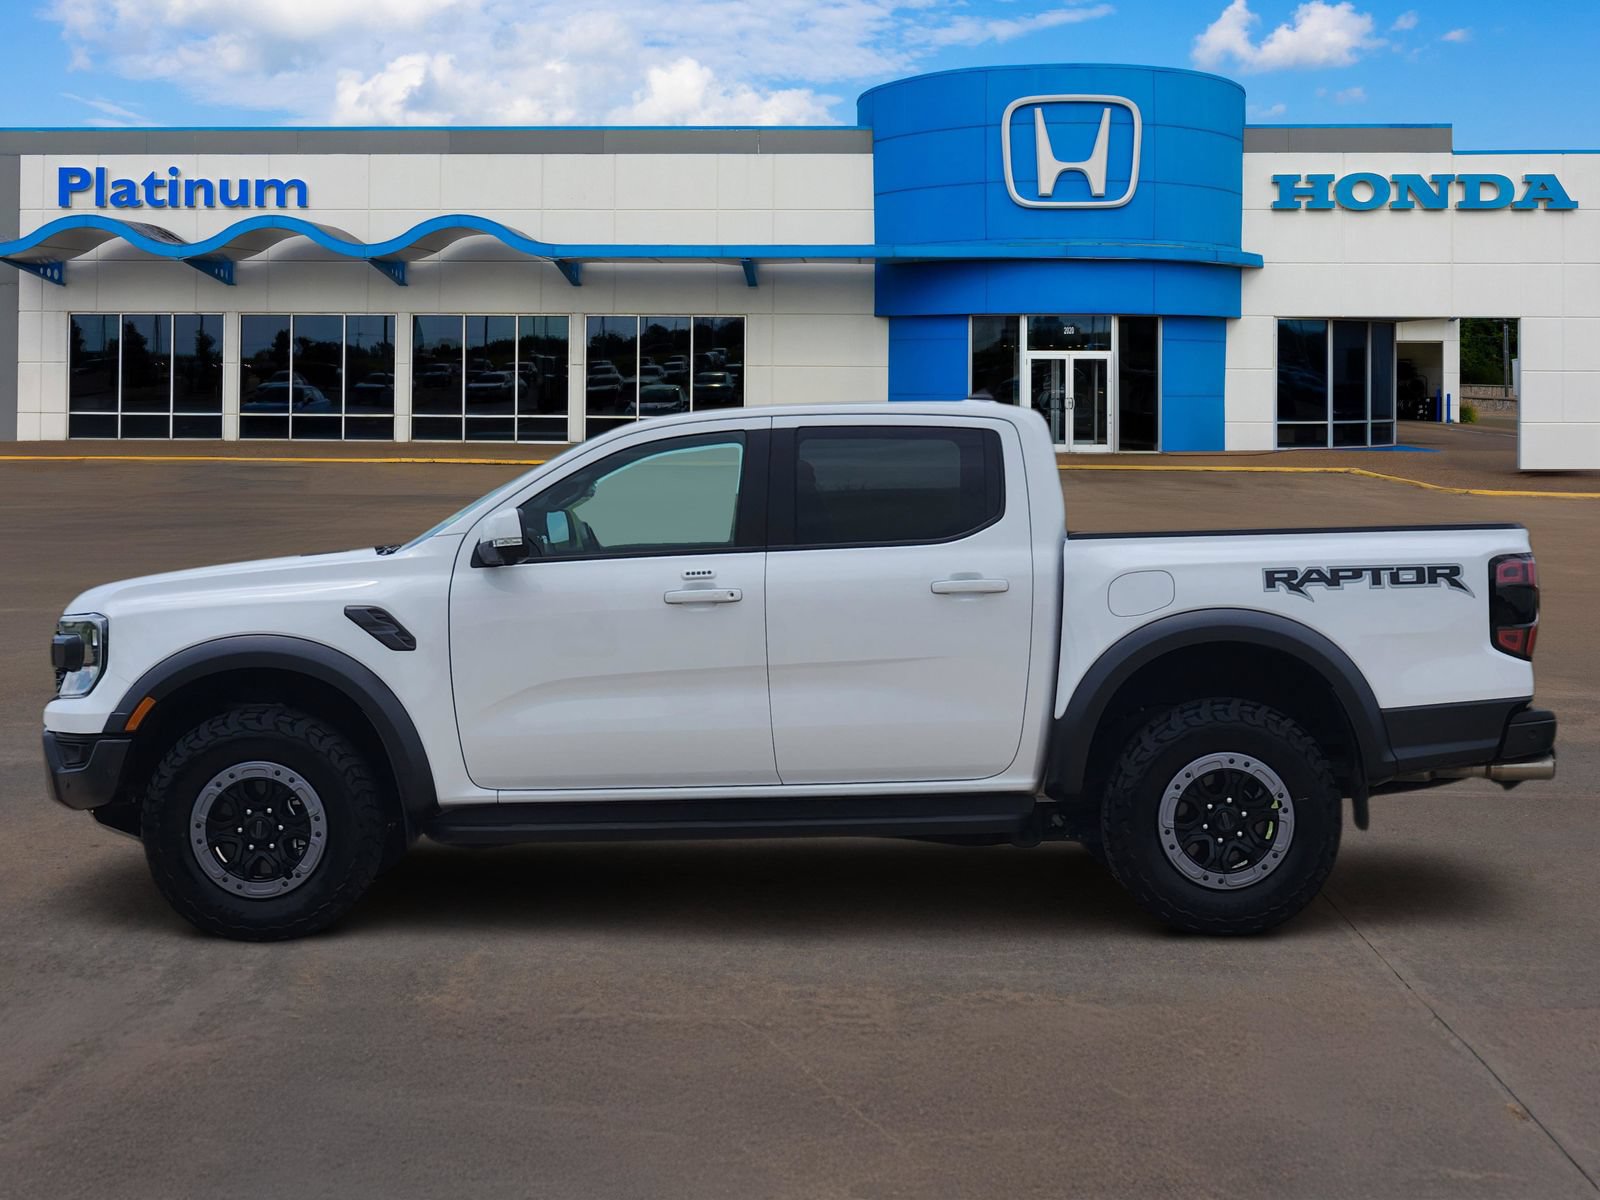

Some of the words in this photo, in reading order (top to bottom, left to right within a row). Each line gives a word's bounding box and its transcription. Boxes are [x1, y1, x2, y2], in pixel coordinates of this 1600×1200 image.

[58, 166, 308, 208] Platinum
[1271, 172, 1578, 210] HONDA
[1262, 563, 1475, 602] RAPTOR
